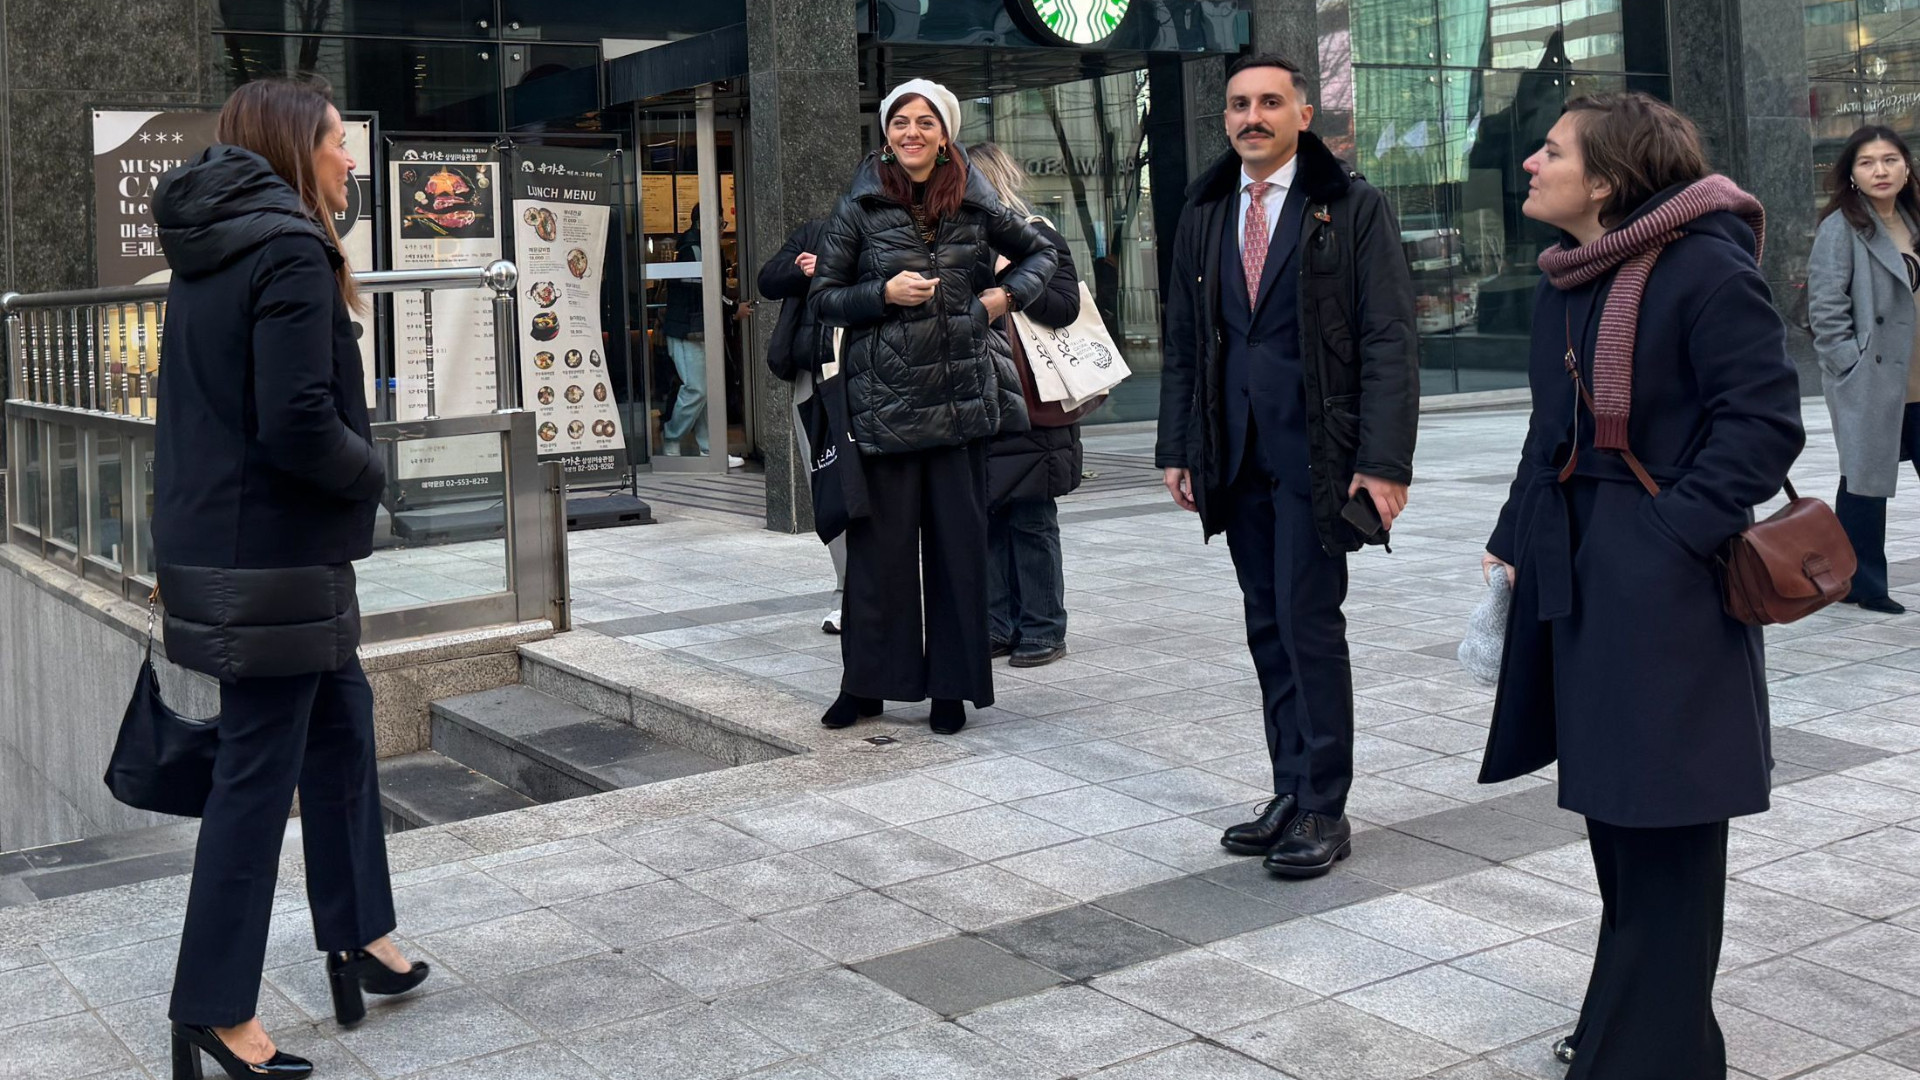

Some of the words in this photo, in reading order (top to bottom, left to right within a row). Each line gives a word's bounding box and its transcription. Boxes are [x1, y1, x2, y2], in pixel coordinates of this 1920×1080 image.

[537, 162, 566, 176] 육가온
[118, 175, 159, 198] CA
[526, 184, 559, 199] LUNCH
[563, 188, 597, 202] MENU
[119, 200, 149, 215] tre
[445, 477, 489, 487] 02-553-8292
